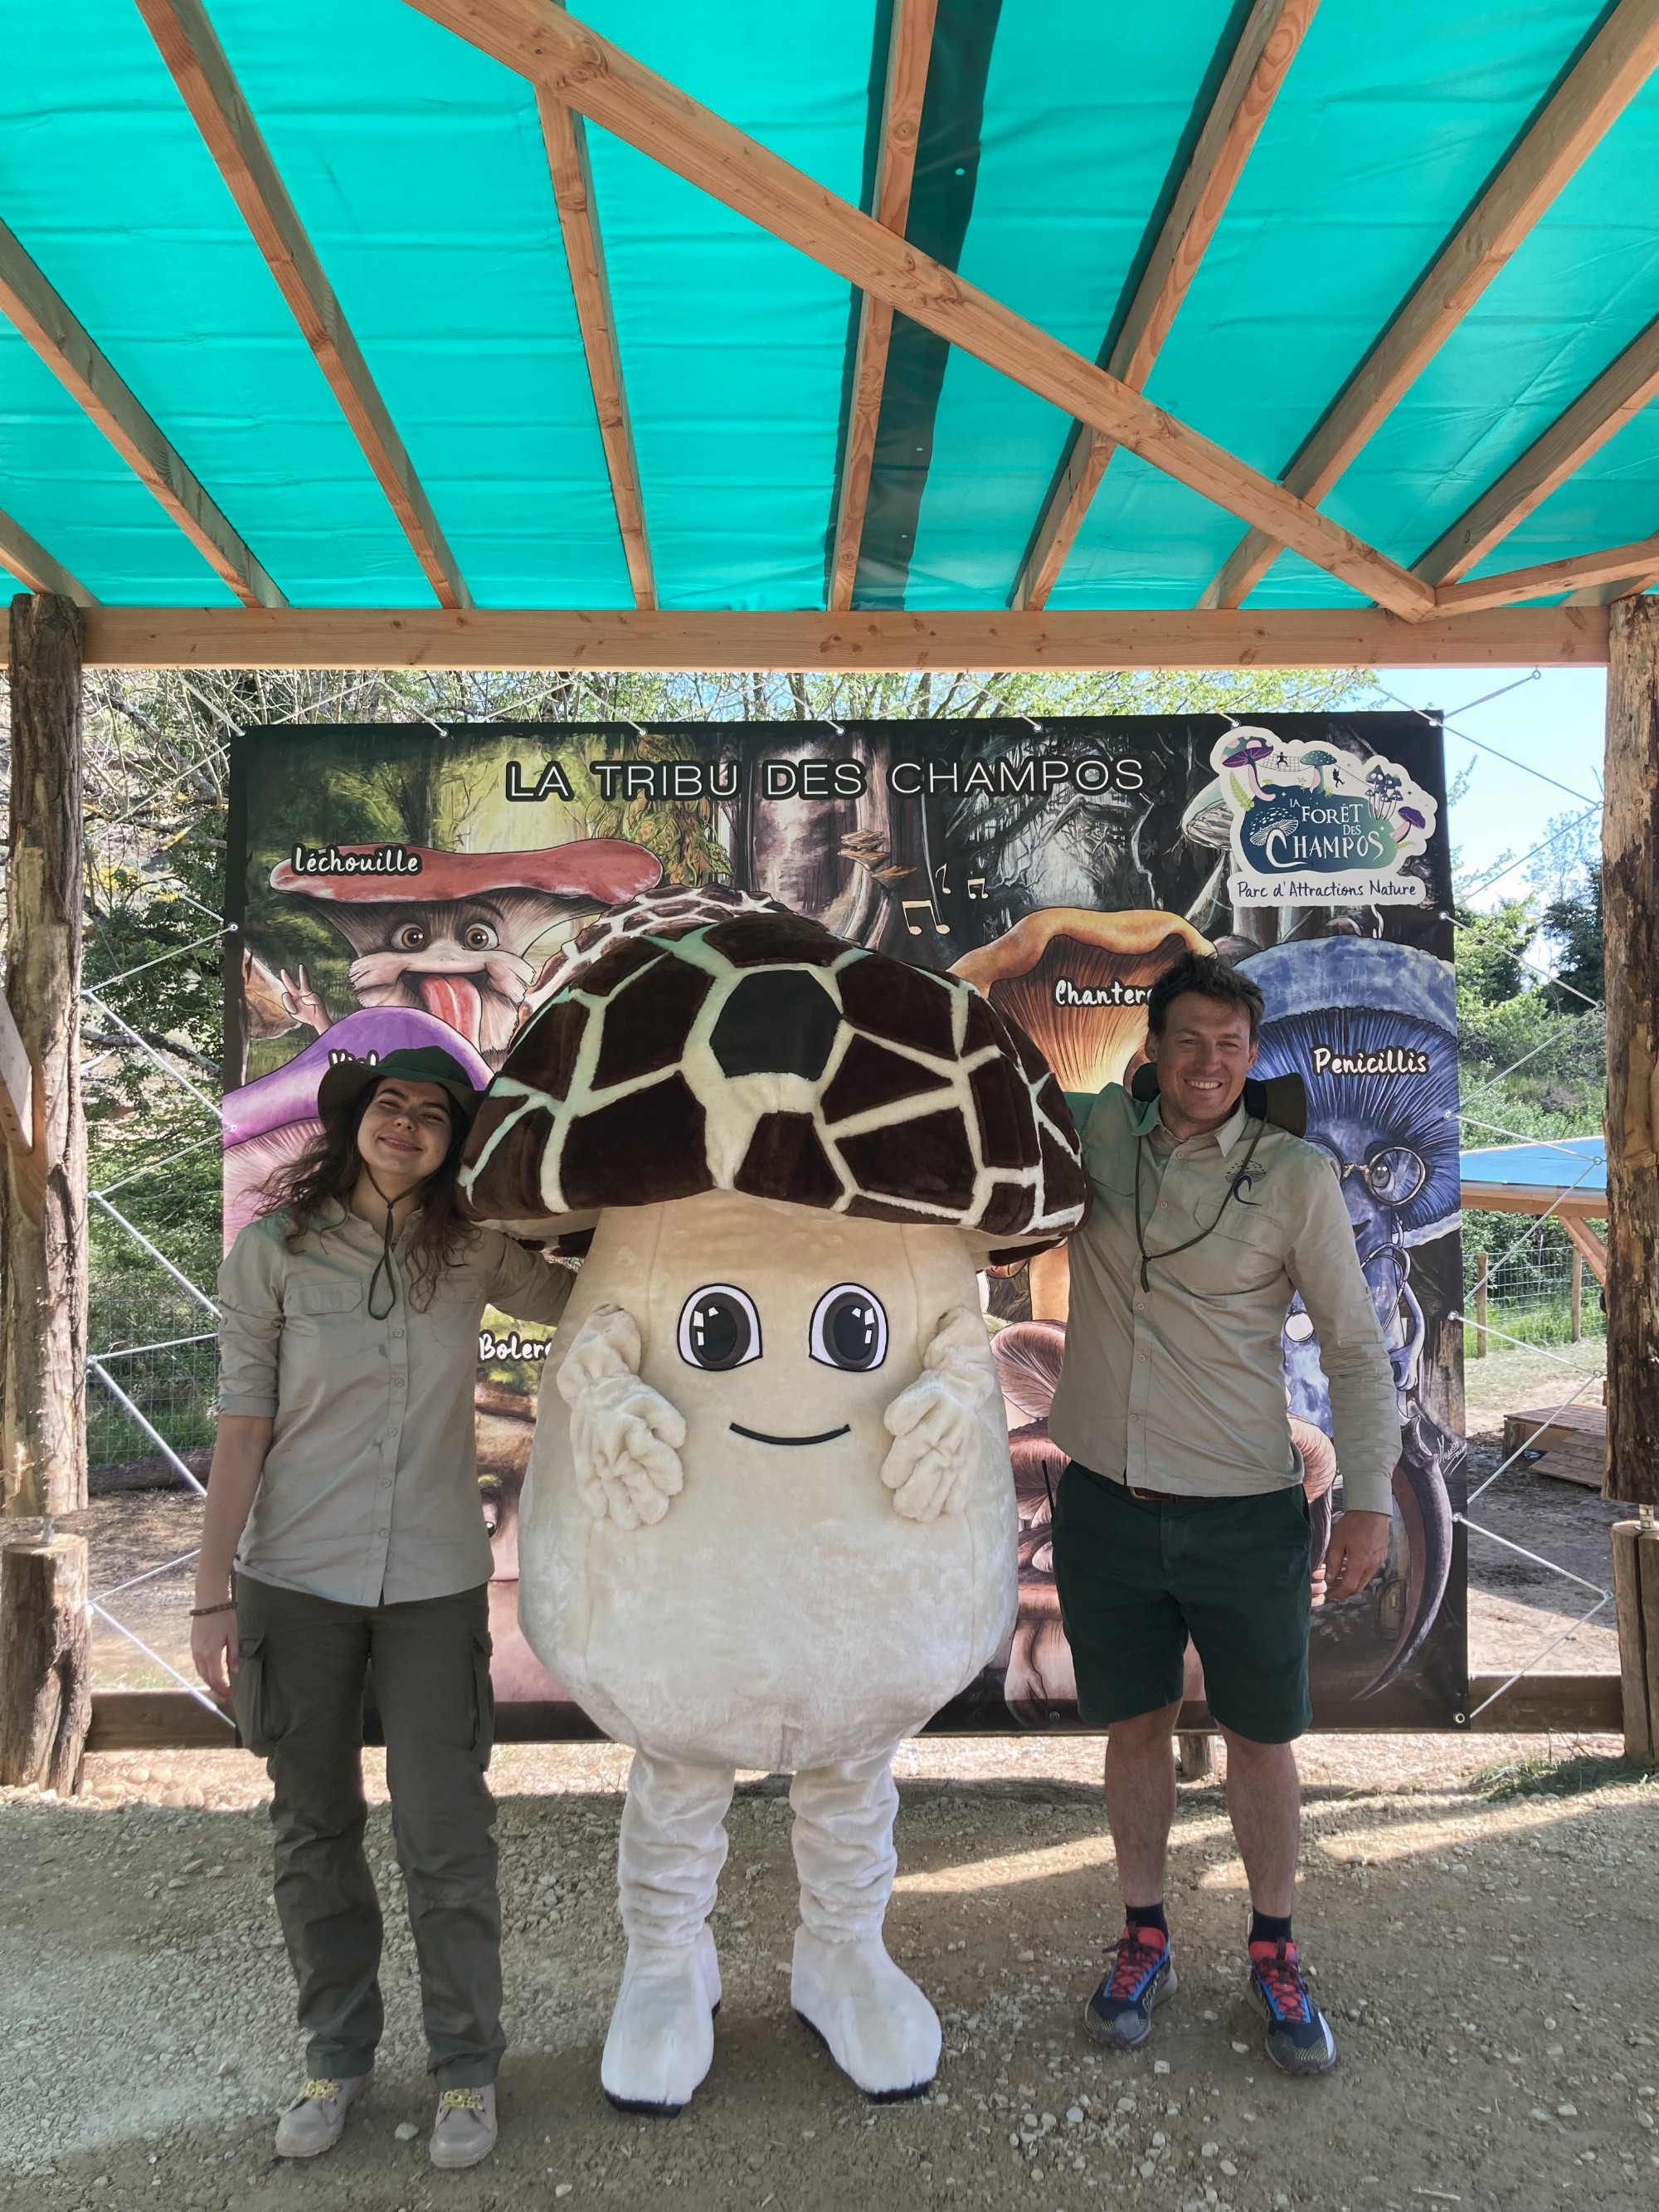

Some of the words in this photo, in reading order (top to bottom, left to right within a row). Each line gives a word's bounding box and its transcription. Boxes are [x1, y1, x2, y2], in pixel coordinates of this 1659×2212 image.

[511, 765, 569, 797] LA
[595, 764, 737, 797] TRIBU
[766, 763, 862, 796] DES
[892, 758, 1144, 794] CHAMPOS
[1289, 797, 1301, 808] LA
[1301, 802, 1364, 825] FORÊT
[1342, 824, 1362, 836] DES
[295, 846, 419, 873] léchouille
[1265, 828, 1384, 869] CHAMPOS
[1237, 881, 1268, 899] Parc
[1369, 879, 1417, 896] Nature
[1313, 1046, 1427, 1074] Penicillis
